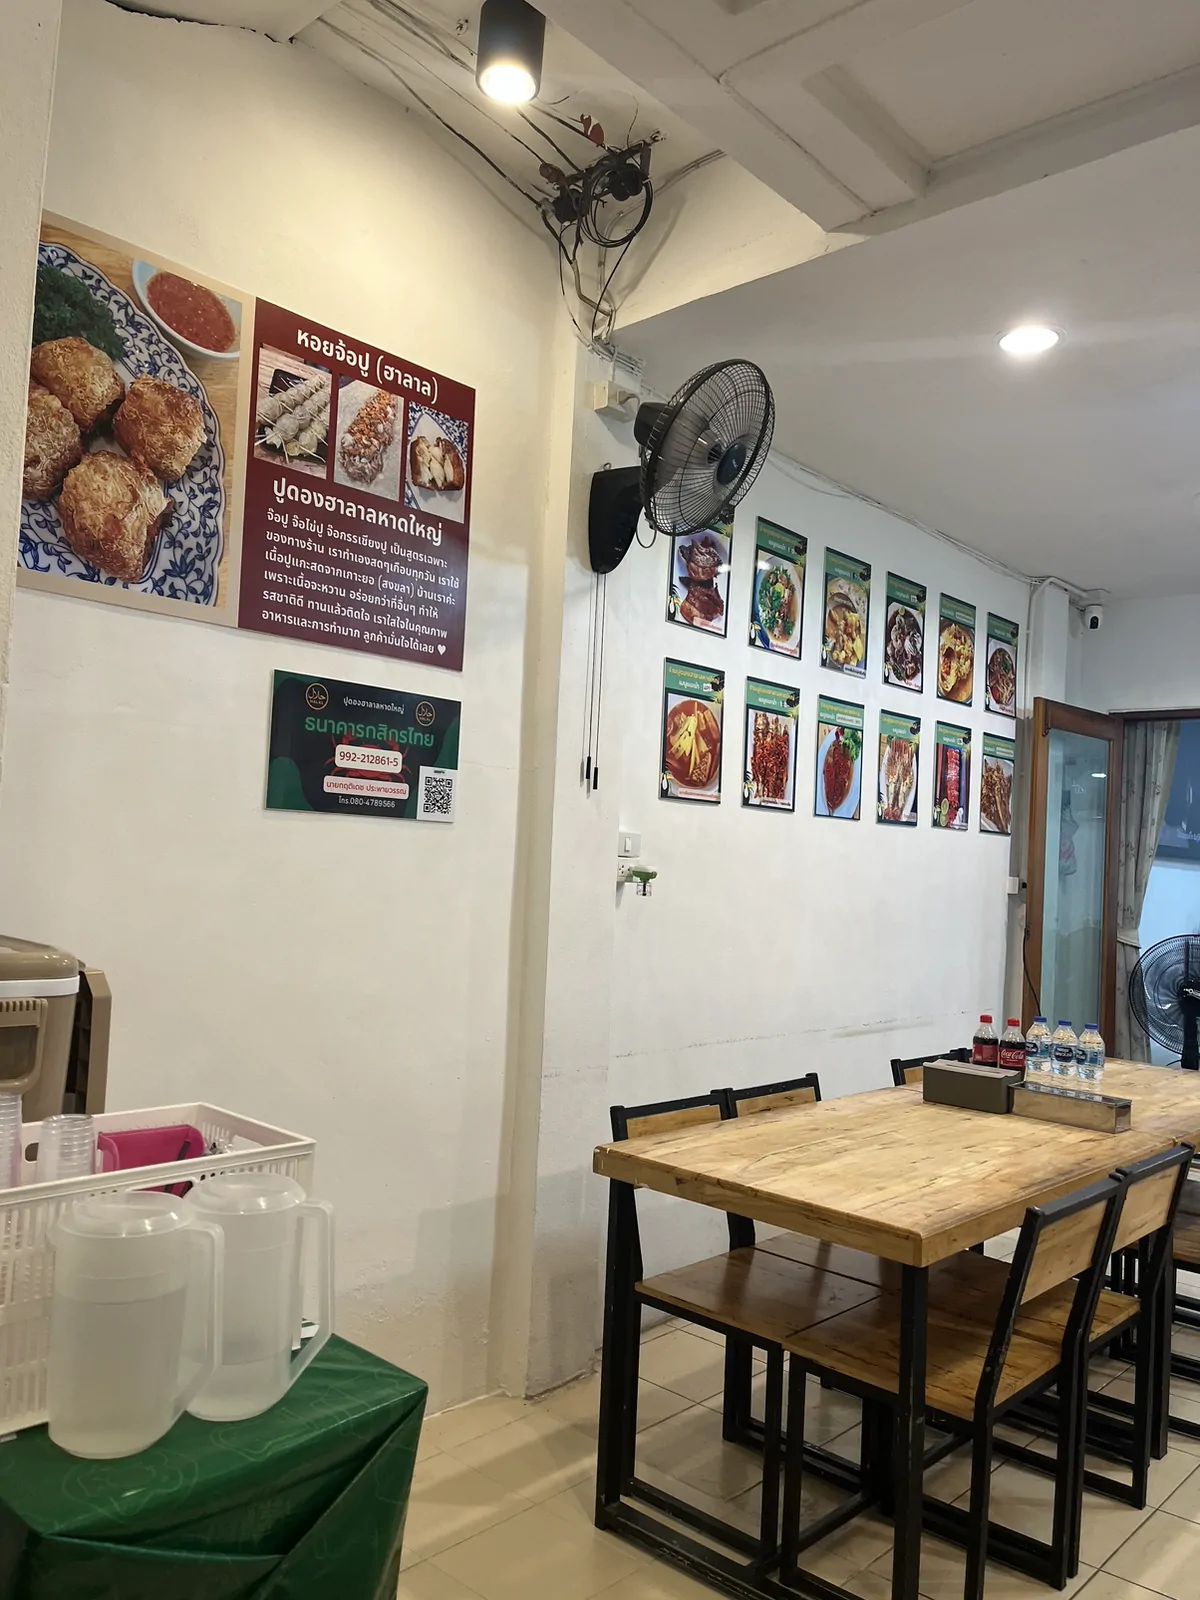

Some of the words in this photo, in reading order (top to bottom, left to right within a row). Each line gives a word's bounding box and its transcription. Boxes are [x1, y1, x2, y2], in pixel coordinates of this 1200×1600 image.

[297, 329, 370, 377] หอยจ้อปู
[376, 355, 438, 404] (ฮาลาล)
[273, 477, 442, 546] ปูดองฮาลาลหาดใหญ่
[267, 507, 289, 529] จ๊อปู
[292, 514, 324, 537] จ๊อไข่ปู
[390, 542, 448, 568] เป็นสูตรเฉพาะ
[266, 530, 325, 553] ของทางร้าน
[438, 575, 460, 589] เราใช้
[264, 570, 346, 598] เพราะเนื้อจะหวาน
[418, 604, 439, 619] ทำให้
[378, 574, 415, 599] (สงขลา)
[262, 590, 304, 607] รสชาติดี
[307, 602, 370, 621] ทานแล้วติดใจ
[363, 630, 434, 653] ลูกค้ามั่นใจได้เลย
[343, 696, 405, 715] ปูดองฮาลาลหาดใหญ่
[304, 716, 435, 747] ธนาคารกสิกรไทย
[339, 750, 399, 767] 992-212861-5
